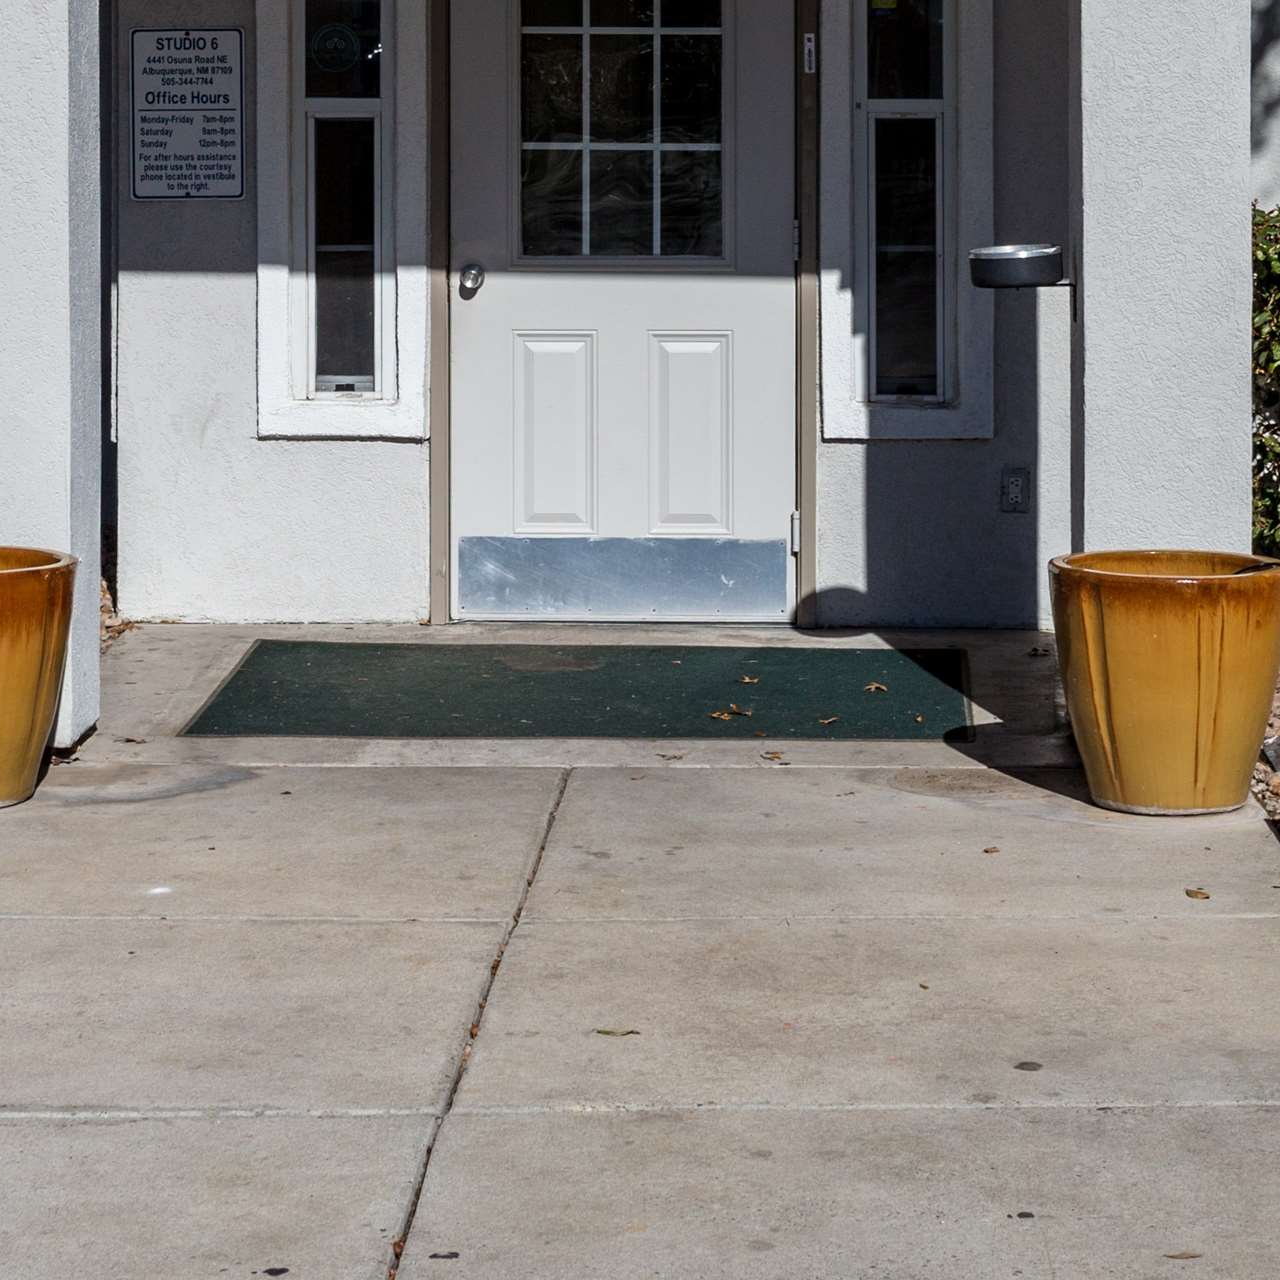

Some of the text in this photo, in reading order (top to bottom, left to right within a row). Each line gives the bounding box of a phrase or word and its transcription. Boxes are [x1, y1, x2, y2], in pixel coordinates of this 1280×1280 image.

[156, 38, 218, 50] STUDIO 6
[142, 68, 194, 76] Albuquerque,
[145, 91, 230, 103] Office Hours
[140, 116, 194, 125] Monday-Friday
[140, 128, 173, 137] Saturday
[140, 140, 167, 149] Sunday
[144, 163, 168, 172] please
[191, 183, 210, 192] right.
